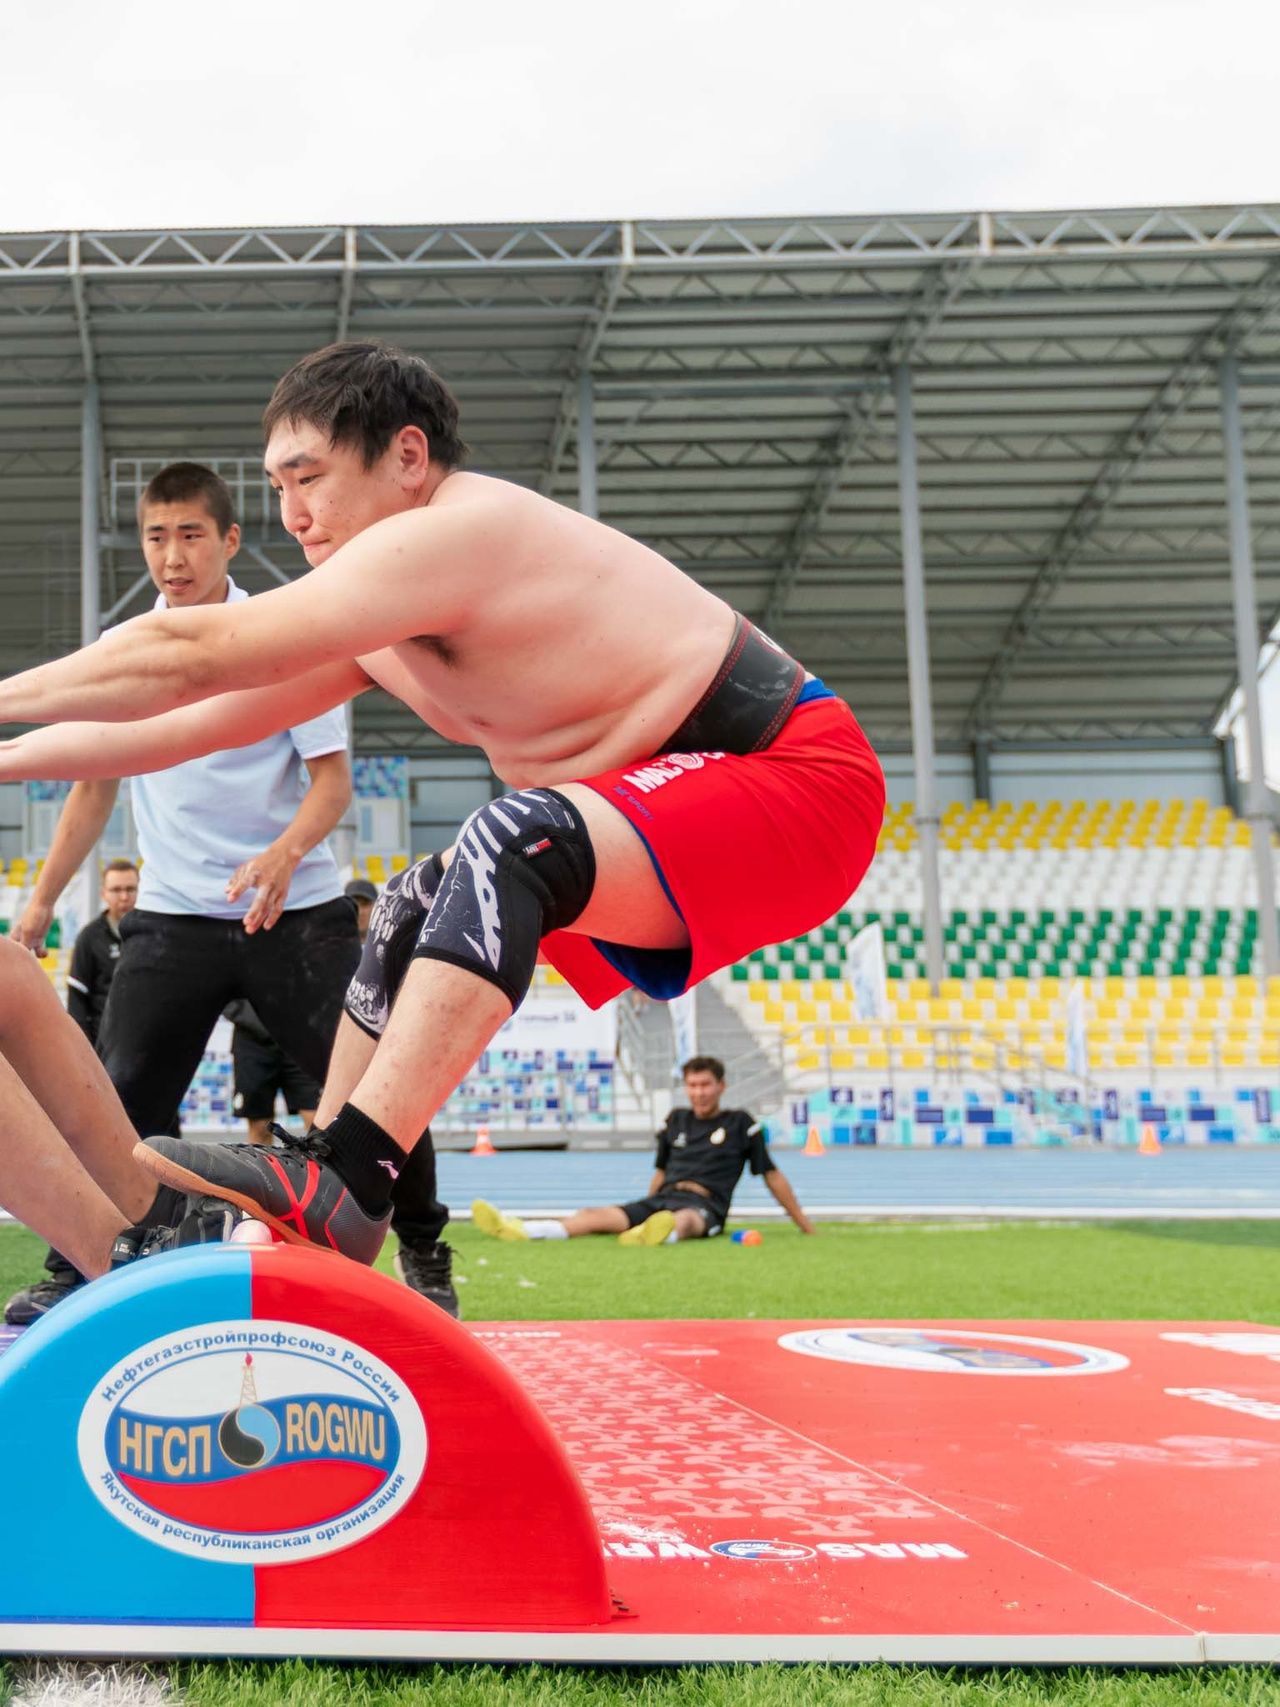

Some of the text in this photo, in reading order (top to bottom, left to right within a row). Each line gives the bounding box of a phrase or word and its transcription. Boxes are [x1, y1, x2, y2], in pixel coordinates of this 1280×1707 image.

[101, 1330, 401, 1403] Нефтегазстройпрофсоюз России
[119, 1417, 212, 1477] НГСП
[286, 1402, 387, 1461] ROGWU
[100, 1471, 406, 1551] Якутская республиканская организация
[816, 1542, 969, 1559] MAS
